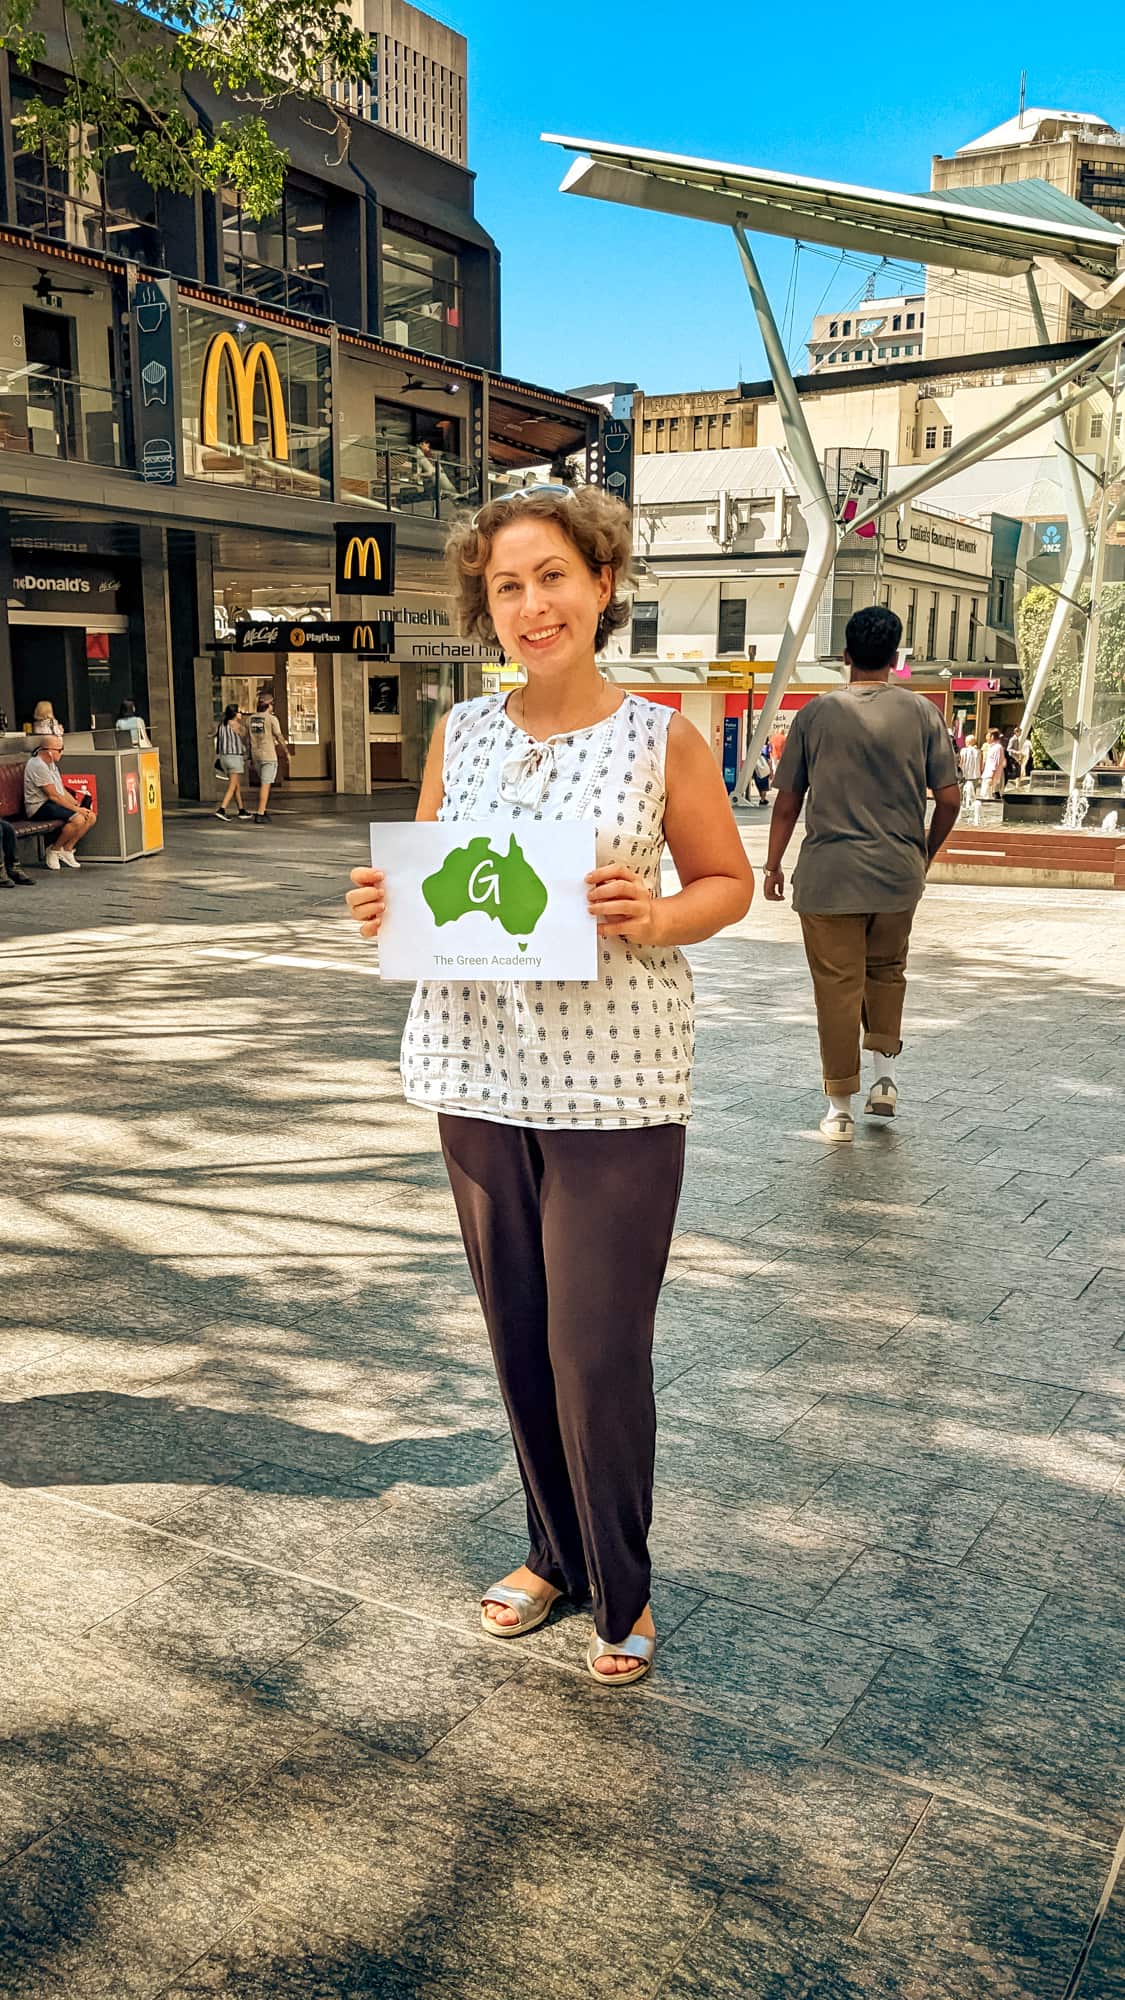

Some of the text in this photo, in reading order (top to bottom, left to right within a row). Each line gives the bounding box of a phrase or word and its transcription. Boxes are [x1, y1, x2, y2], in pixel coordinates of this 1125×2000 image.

[201, 332, 289, 460] M
[1040, 544, 1061, 552] ANZ
[344, 537, 381, 580] M
[378, 606, 432, 625] michael
[412, 641, 475, 657] michael
[468, 859, 501, 905] G
[433, 955, 542, 968] The Green Academy
